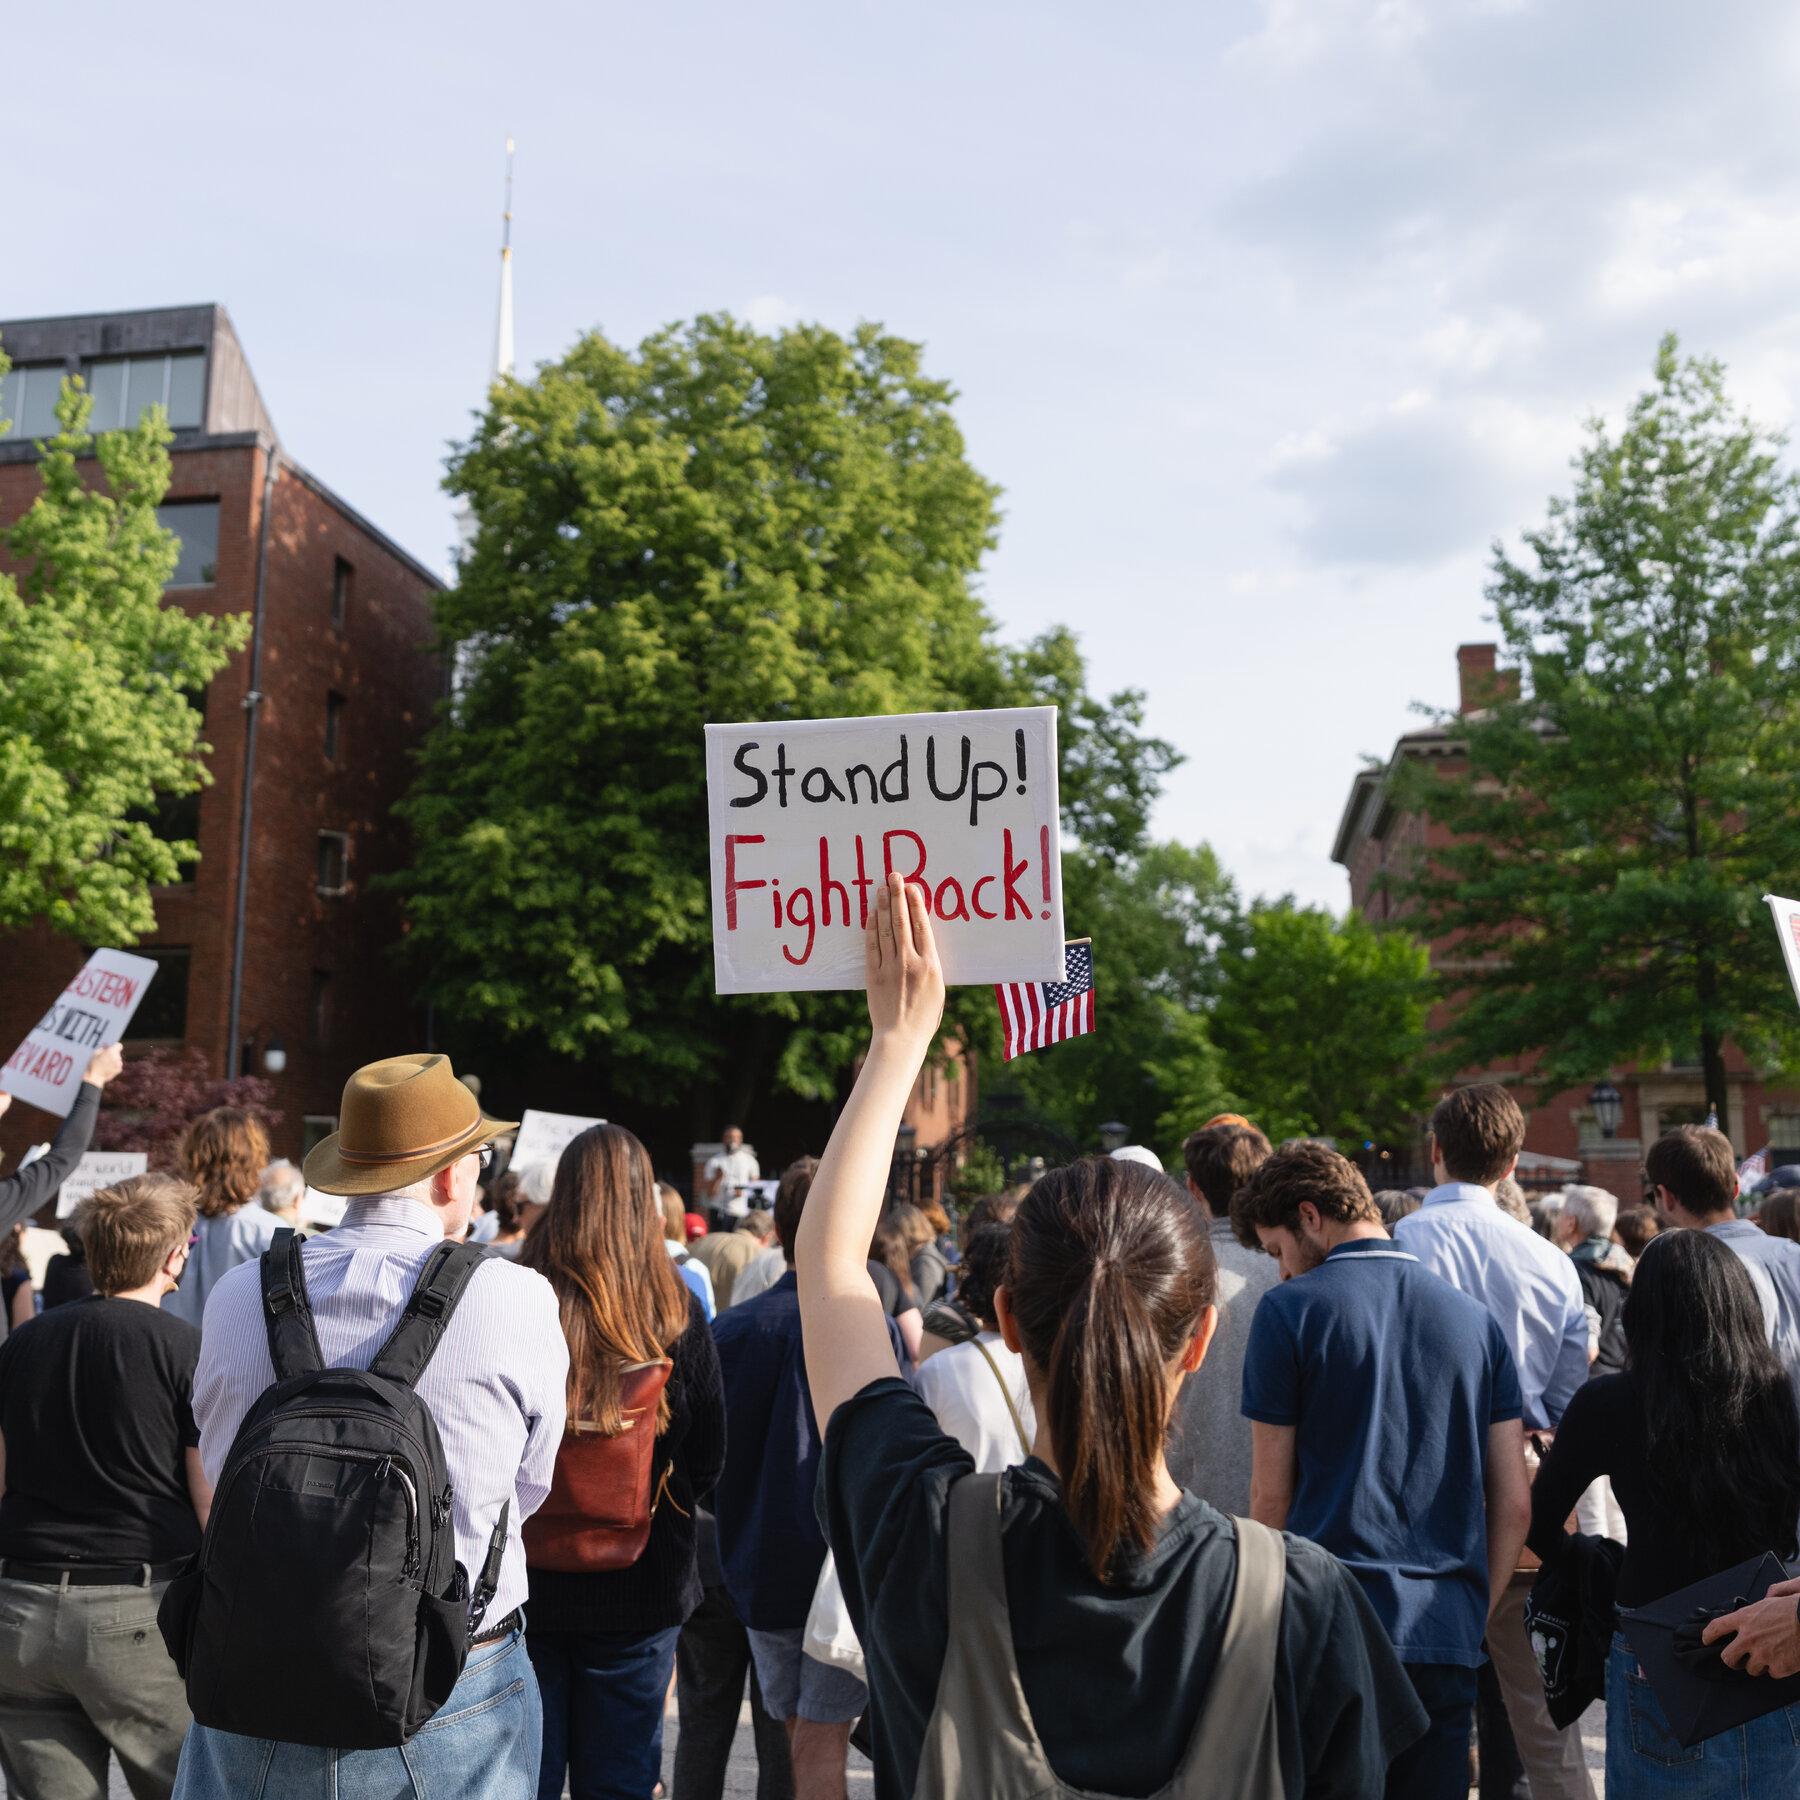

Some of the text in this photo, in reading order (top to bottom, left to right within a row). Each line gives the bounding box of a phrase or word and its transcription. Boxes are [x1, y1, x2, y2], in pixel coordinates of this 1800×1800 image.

[729, 728, 1027, 827] Stand Up!
[725, 824, 1052, 966] Fight Back!
